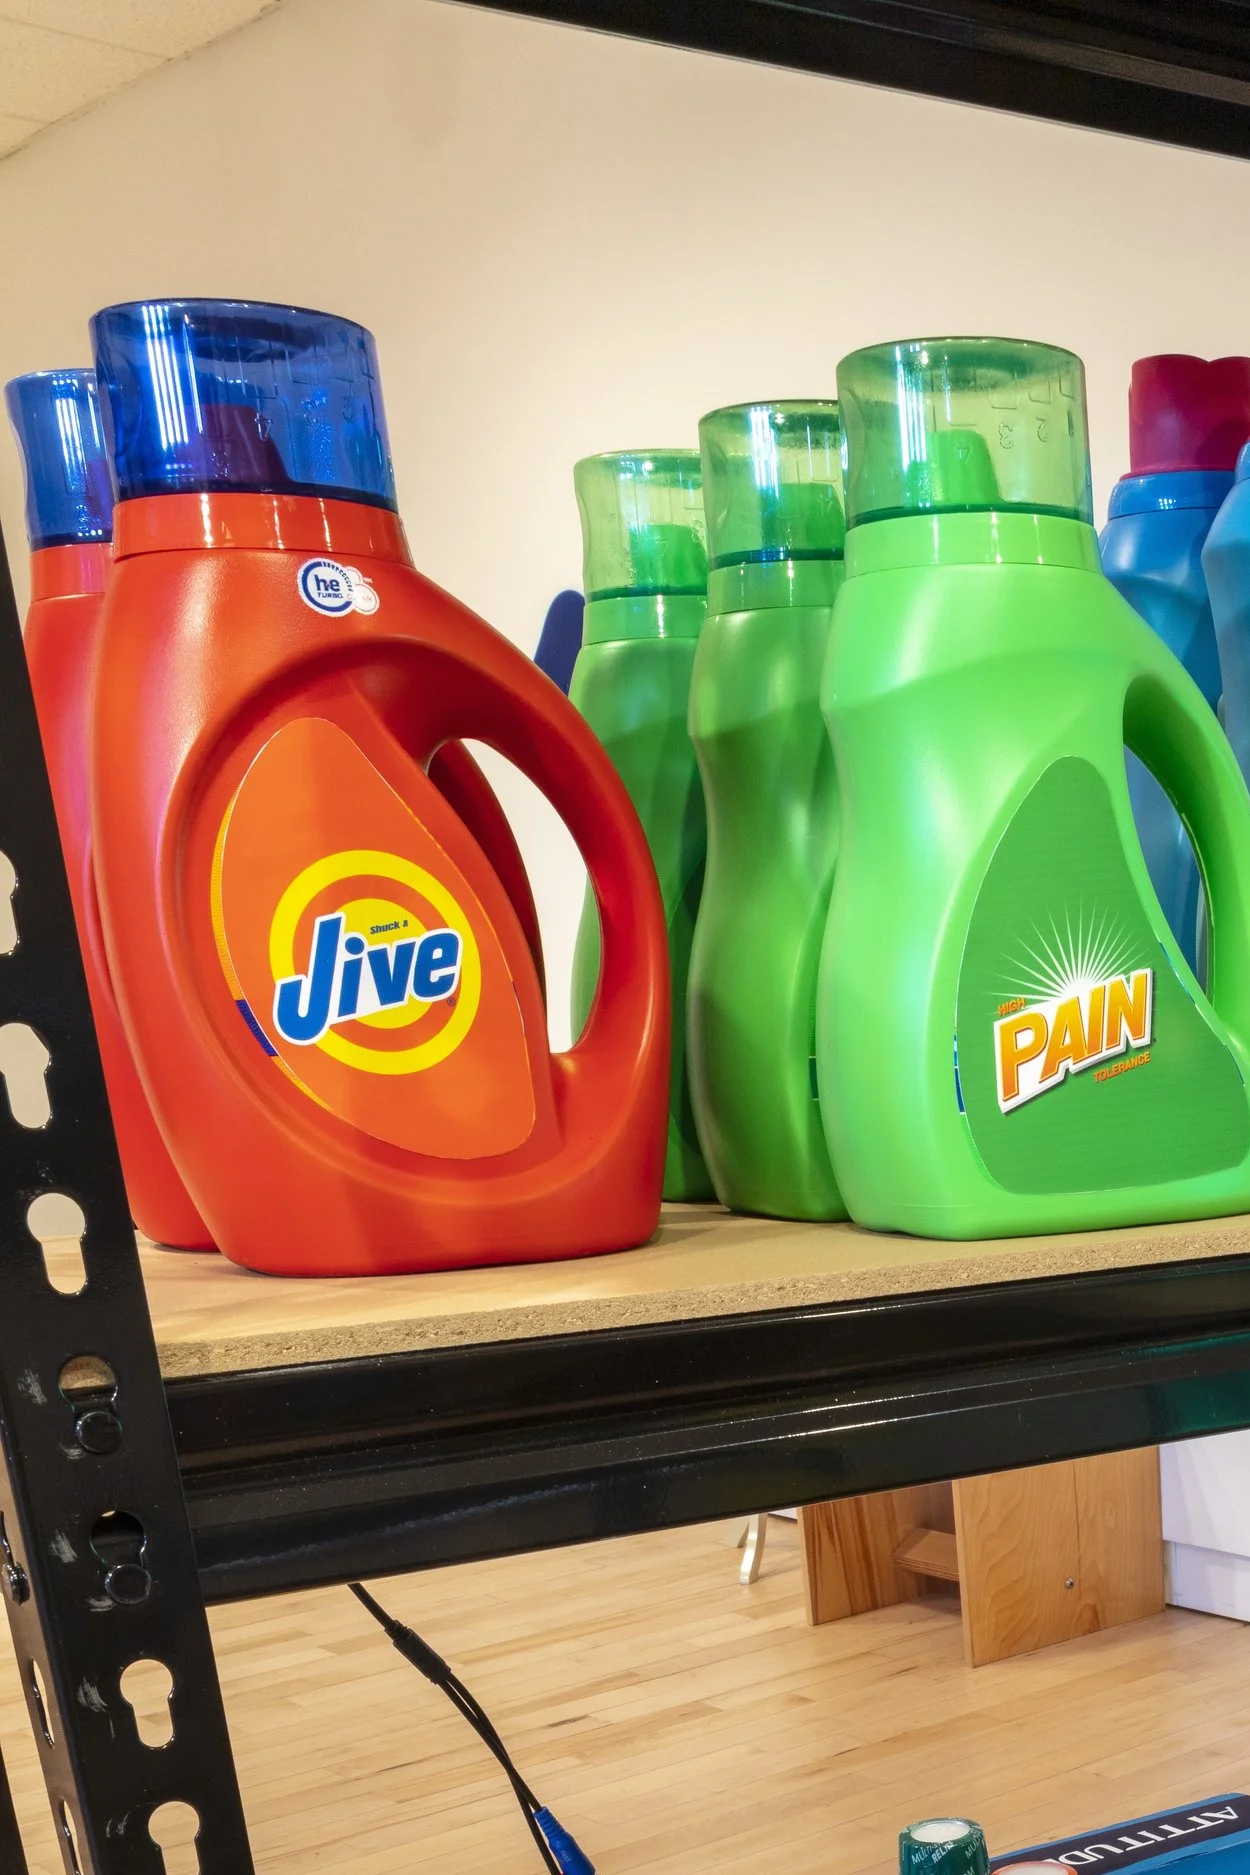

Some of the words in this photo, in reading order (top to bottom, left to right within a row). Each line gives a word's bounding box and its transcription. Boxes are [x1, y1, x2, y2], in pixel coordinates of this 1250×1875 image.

[313, 574, 341, 593] he
[276, 915, 461, 1042] Jive
[997, 997, 1027, 1016] HIGH
[997, 968, 1150, 1105] PAIN
[1092, 1051, 1151, 1083] TOLERANCE
